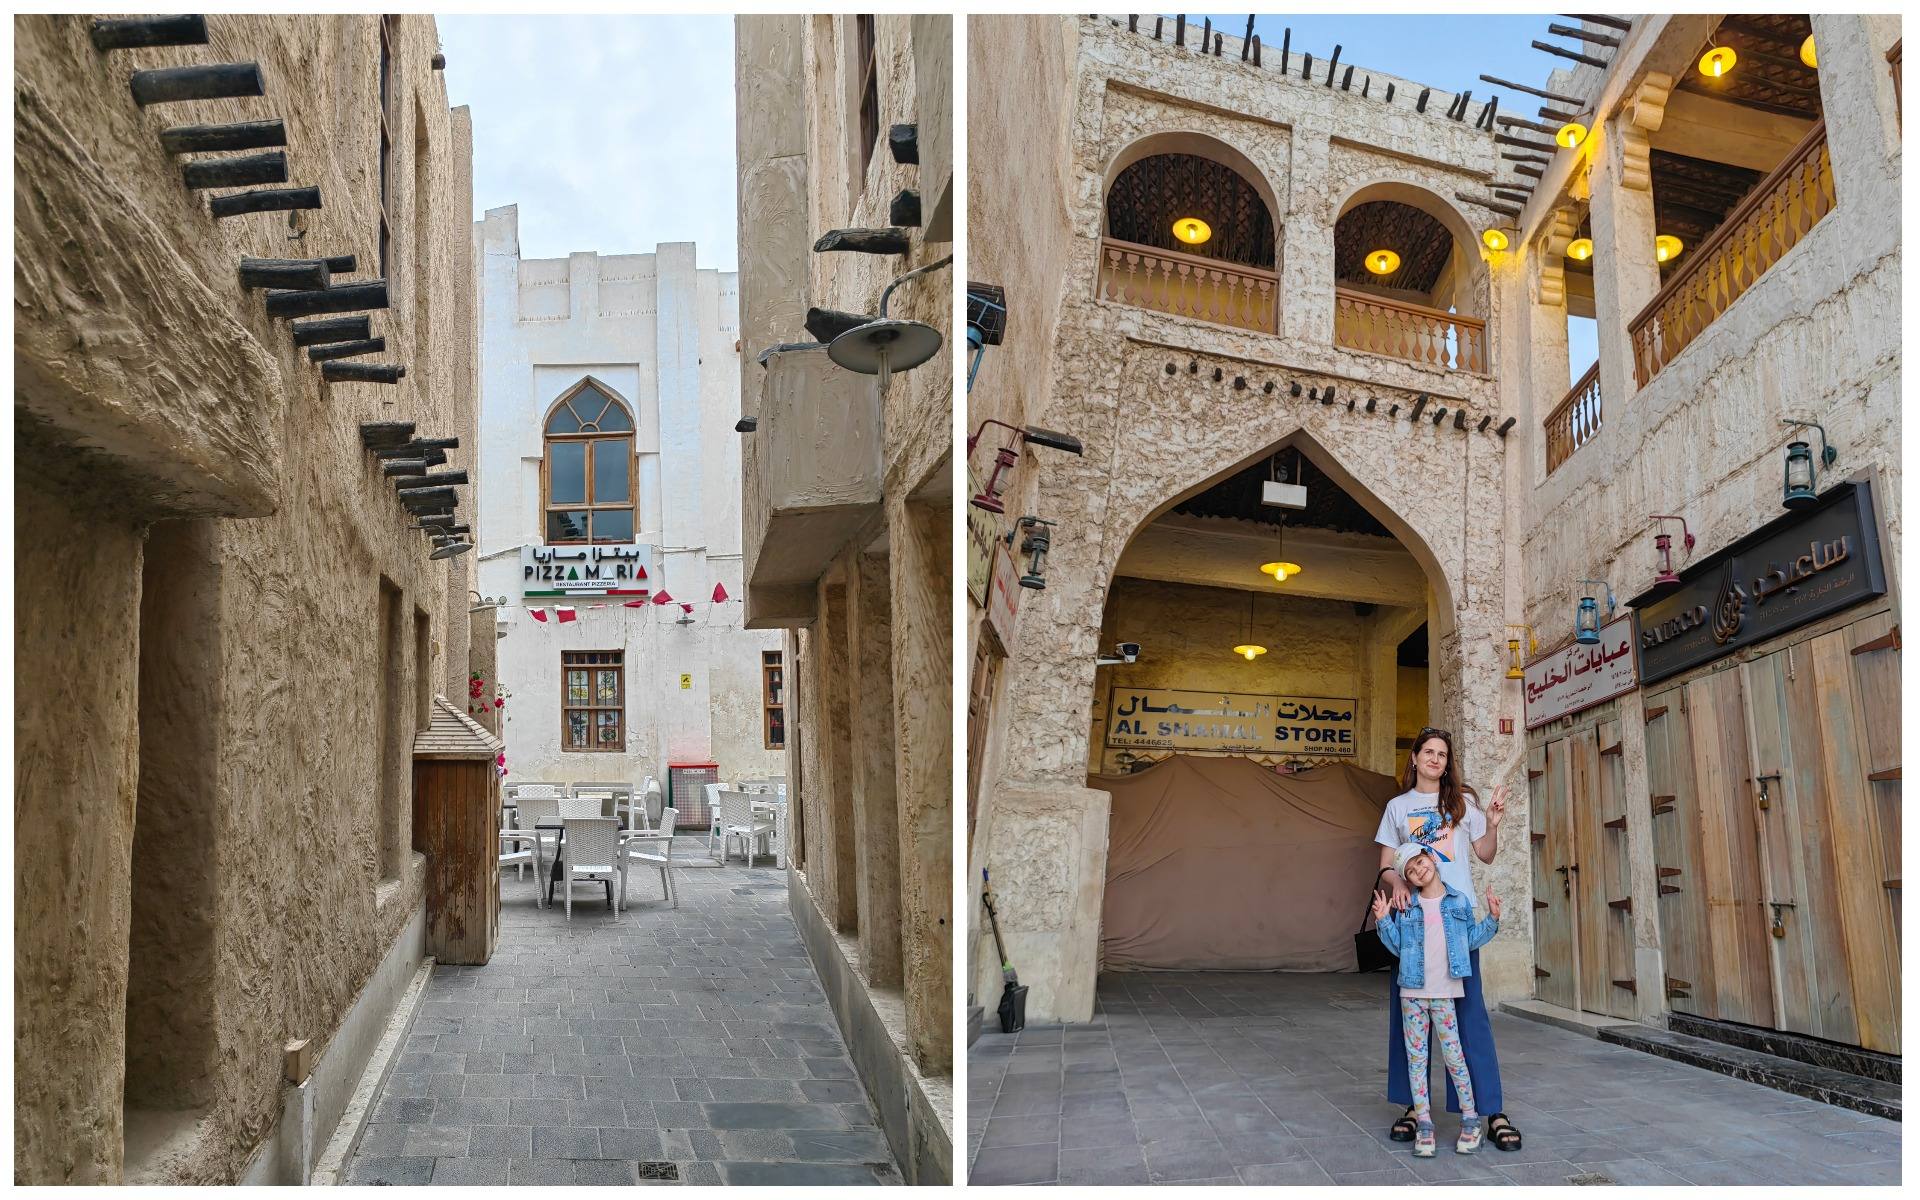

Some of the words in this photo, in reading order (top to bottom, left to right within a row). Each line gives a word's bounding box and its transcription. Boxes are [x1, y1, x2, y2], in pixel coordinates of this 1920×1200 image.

[532, 547, 587, 564] ماريا
[592, 546, 640, 563] بيتزا
[524, 565, 579, 581] PIZZA
[585, 564, 648, 580] MARIA
[1574, 640, 1631, 676] عبايات
[1526, 660, 1572, 704] الخليج
[1277, 702, 1352, 721] محلات
[1115, 719, 1147, 735] AL
[1157, 721, 1262, 740] SHAMAL
[1274, 725, 1352, 743] STORE
[1112, 737, 1132, 745] TEL:
